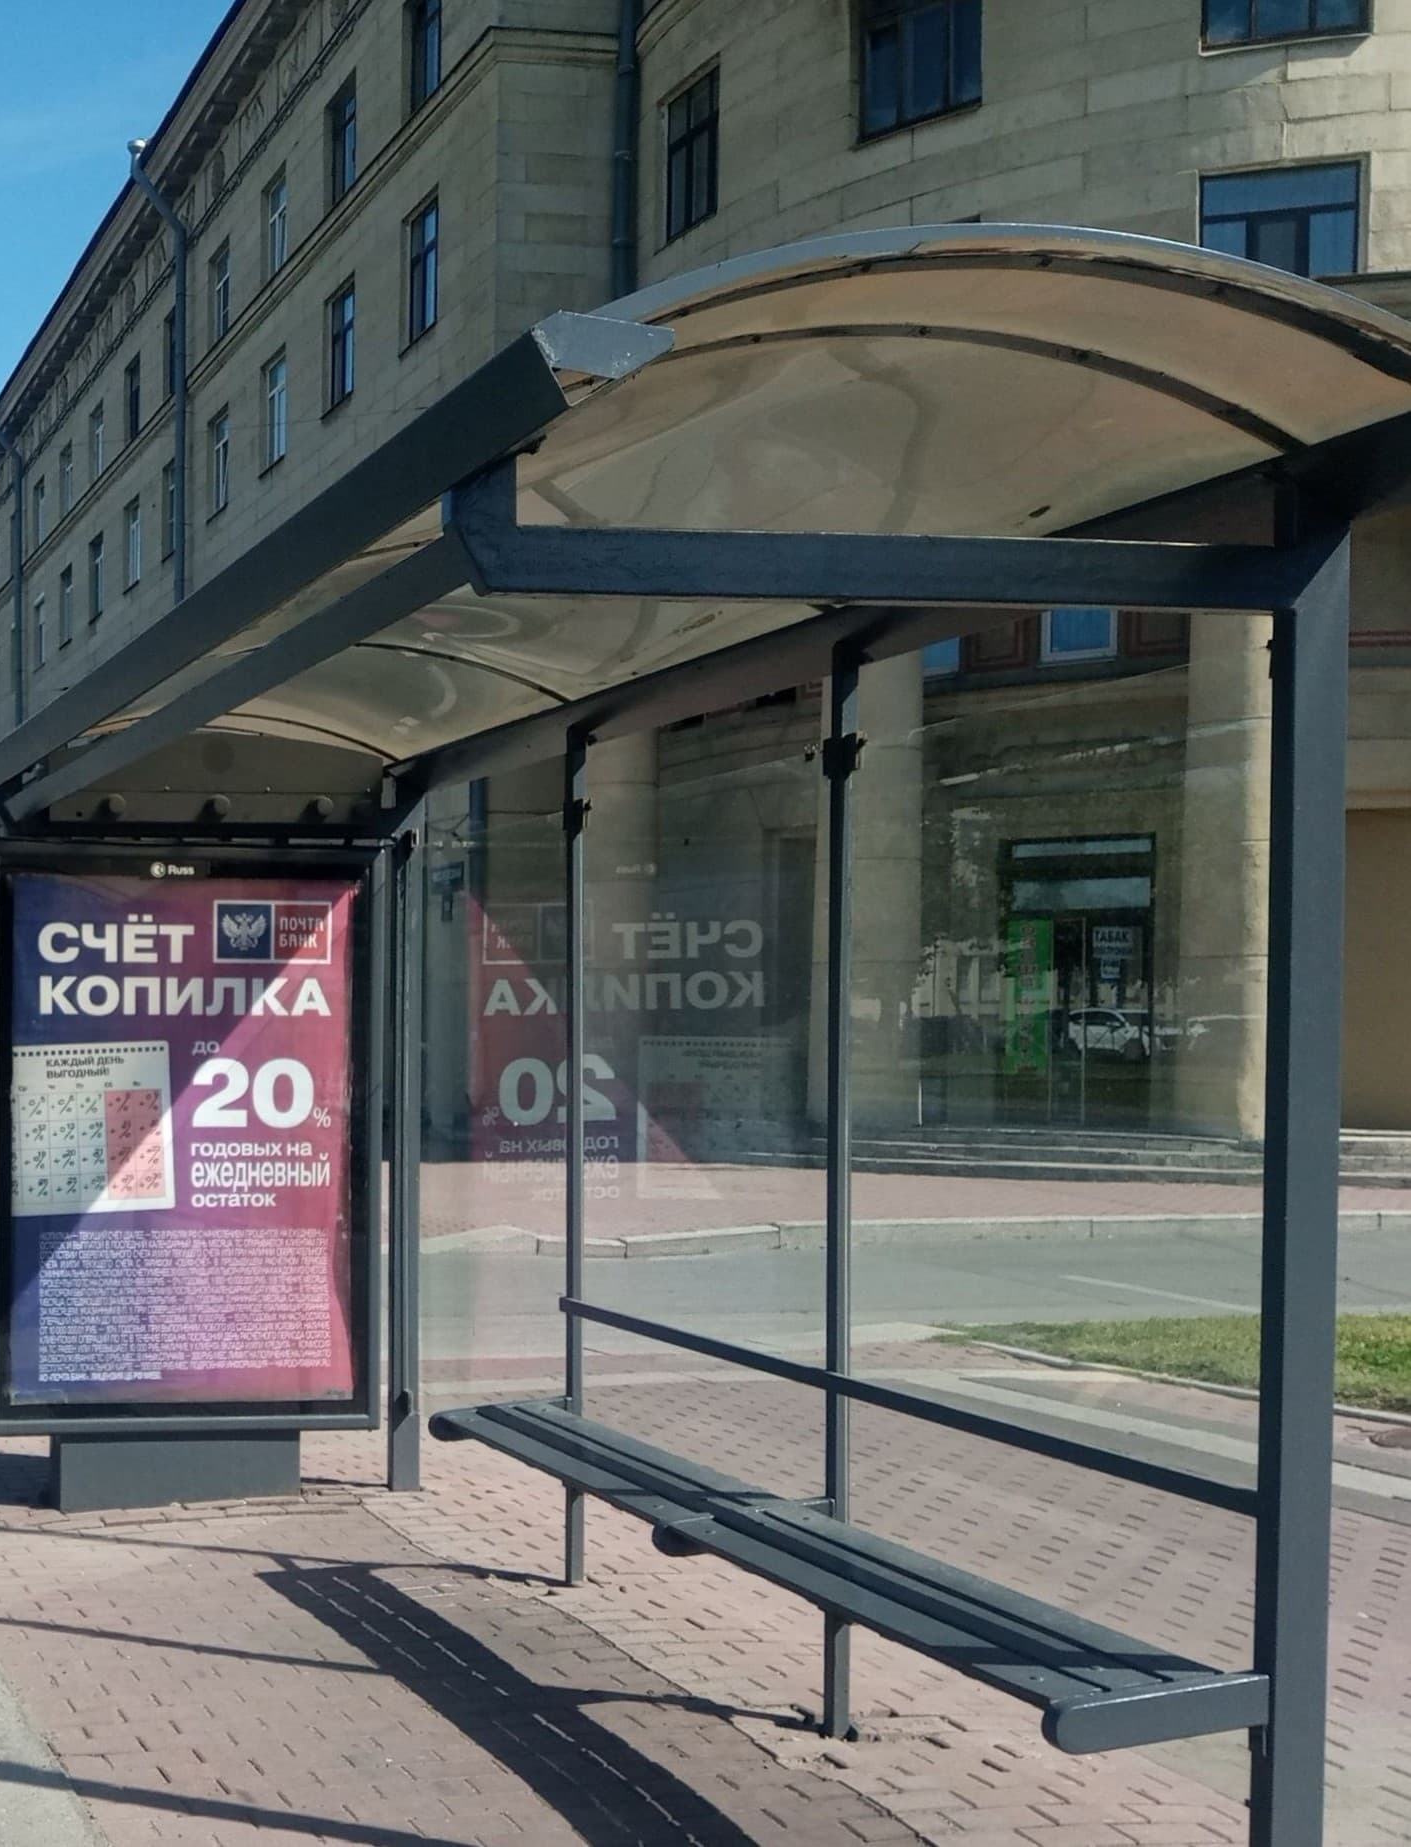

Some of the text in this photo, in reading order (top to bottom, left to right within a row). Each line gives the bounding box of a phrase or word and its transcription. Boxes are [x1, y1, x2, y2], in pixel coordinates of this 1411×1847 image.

[167, 864, 195, 876] Russ
[279, 917, 324, 932] ПОЧТА
[38, 914, 195, 963] СЧЁТ
[279, 933, 318, 948] БАНК
[1095, 930, 1130, 943] ТАБАК
[38, 975, 332, 1017] КОПИЛКА
[45, 1055, 125, 1068] КАЖДЫЙ ДЕНЬ
[191, 1141, 313, 1158] годовых на
[191, 1152, 330, 1192] ежедневный
[191, 1192, 277, 1208] остаток
